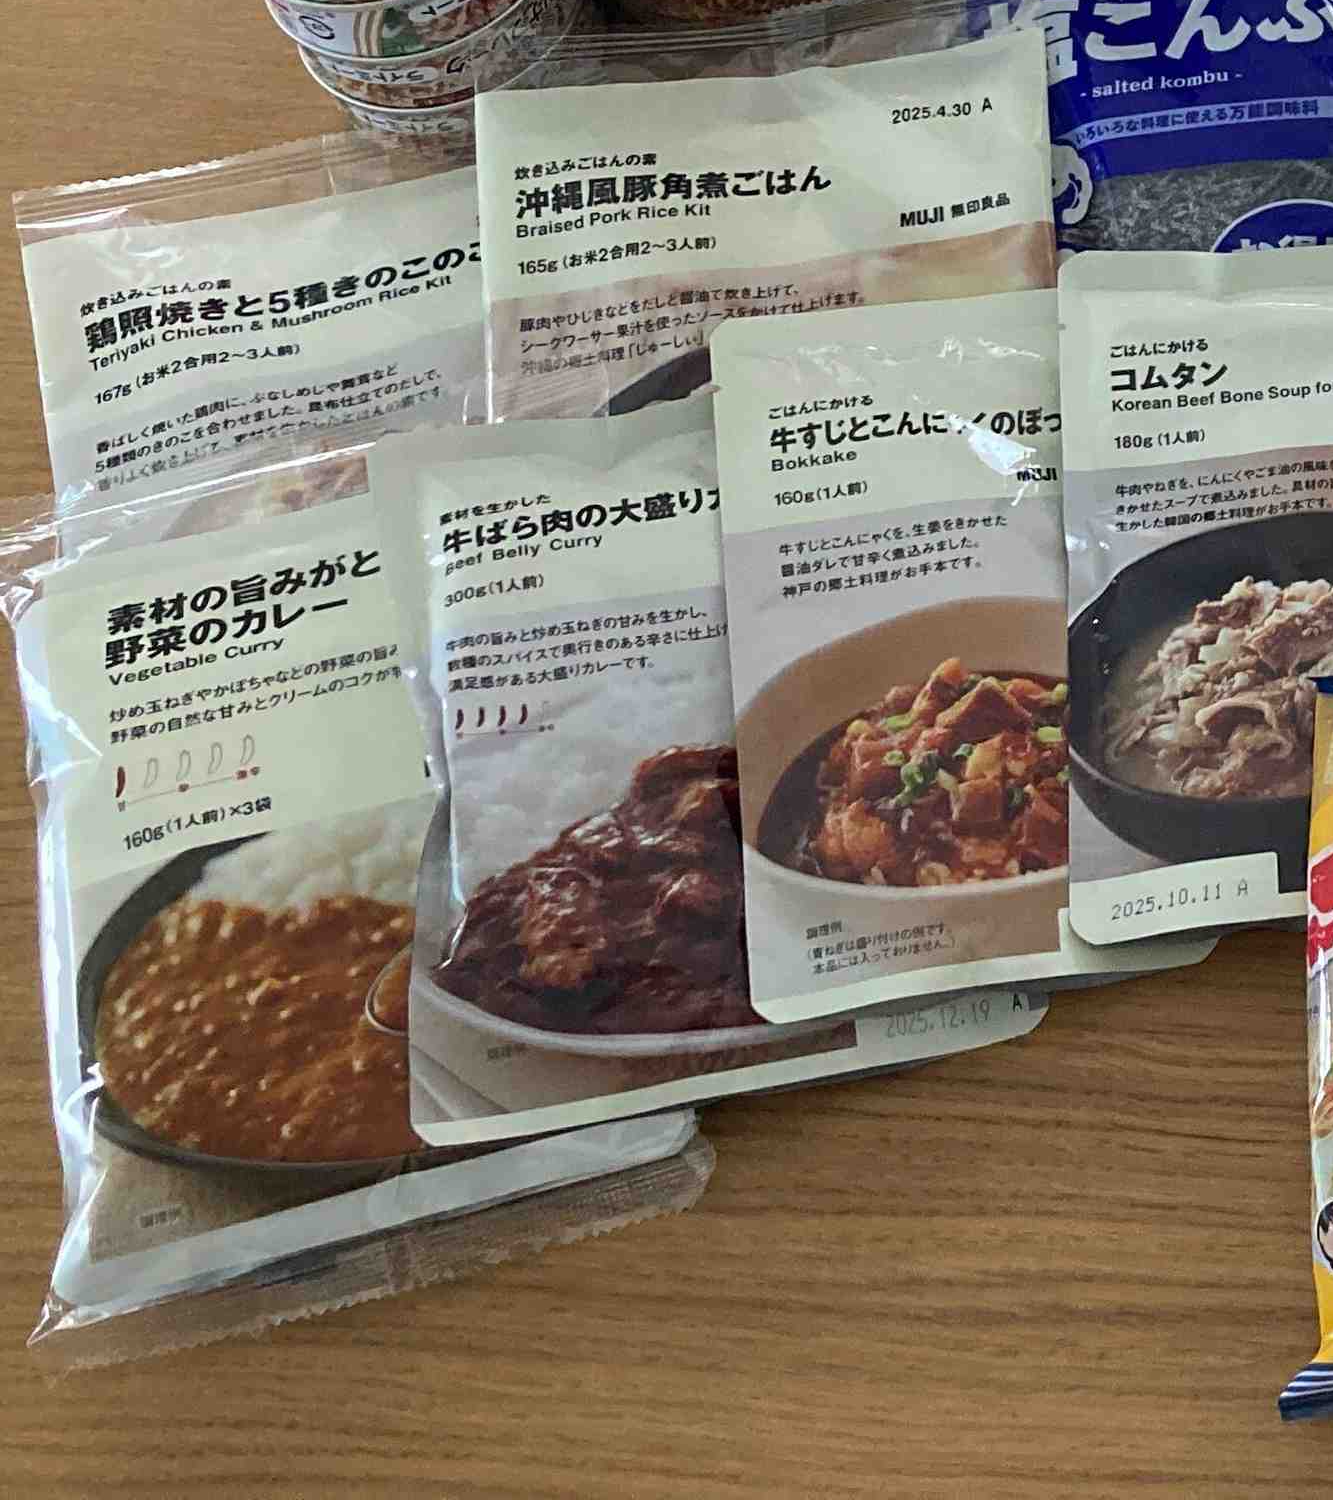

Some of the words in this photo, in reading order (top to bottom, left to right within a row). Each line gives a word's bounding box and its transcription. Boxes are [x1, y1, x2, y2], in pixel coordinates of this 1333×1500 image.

[1091, 74, 1155, 99] salted
[1159, 67, 1230, 91] kombu
[891, 102, 973, 126] 2025.4.30
[981, 97, 994, 115] A
[514, 152, 657, 182] 炊き込みごはんの素
[515, 164, 832, 220] 沖縄風豚角煮ごはん
[515, 217, 585, 239] Braised
[589, 207, 632, 227] Pork
[637, 205, 680, 220] Rice
[684, 203, 712, 218] Kit
[88, 337, 157, 374] Teriyaki
[161, 321, 245, 345] Chicken
[248, 318, 265, 333] &
[270, 294, 374, 332] Mushroom
[377, 283, 421, 305] Rice
[424, 274, 453, 291] Kit
[1110, 361, 1229, 393] コムタン
[1111, 395, 1173, 413] Korean
[1176, 392, 1216, 409] Beef
[1220, 387, 1265, 404] Bone
[1268, 382, 1312, 403] Soup
[770, 448, 858, 473] Bokkake
[438, 493, 553, 527] 素材を生かした
[444, 552, 484, 577] Beef
[491, 543, 541, 563] Belly
[549, 533, 604, 552] Curry
[778, 514, 1009, 557] 牛すじとこんにゃくを、生姜をきかせた
[779, 540, 982, 578] 醤油ダレで甘辛く煮込みました。
[781, 559, 984, 600] 神戸の郷土料理がお手本です。
[106, 549, 382, 636] 素材の旨みがと
[104, 597, 349, 671] 野菜のカレー
[107, 650, 218, 688] Vegetable
[224, 636, 286, 664] Curry
[1110, 881, 1223, 922] 2025.10.11
[1236, 878, 1250, 896] A
[884, 999, 991, 1040] 2025.12.19
[1011, 993, 1024, 1010] A
